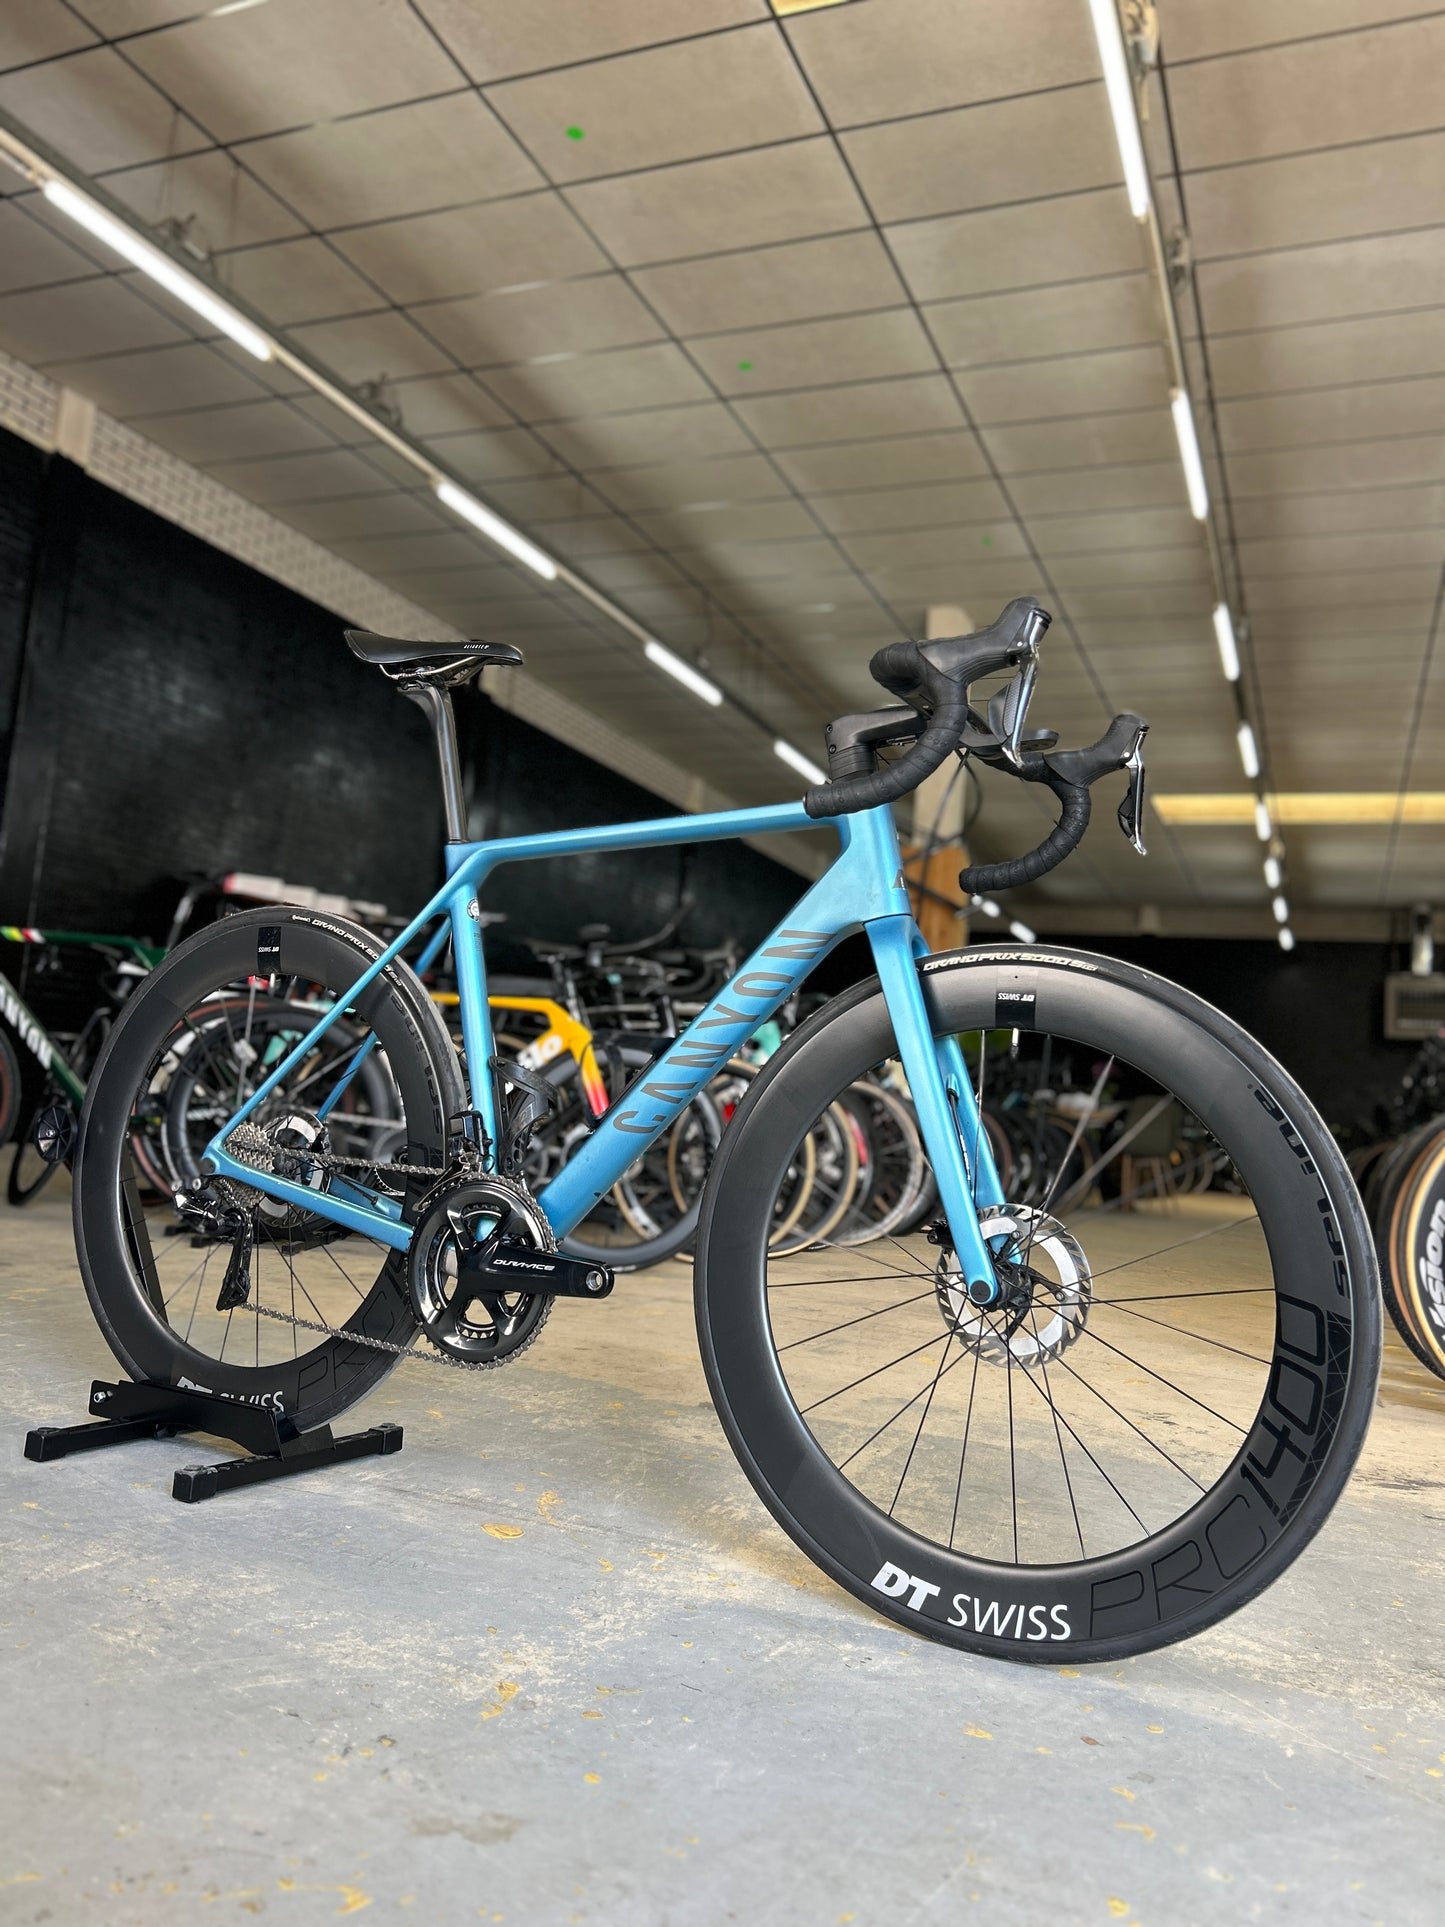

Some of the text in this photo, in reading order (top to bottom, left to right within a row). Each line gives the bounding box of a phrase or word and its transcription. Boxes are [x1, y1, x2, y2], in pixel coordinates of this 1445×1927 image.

[311, 918, 345, 936] GRAND
[343, 933, 367, 951] PRIX
[922, 953, 977, 971] GRAND
[977, 951, 1019, 962] PRIX
[1018, 952, 1067, 966] 5000
[997, 992, 1035, 1002] DT SWISS
[612, 929, 837, 1134] CANYON
[870, 1292, 1327, 1641] DT SWISS PRC 1400
